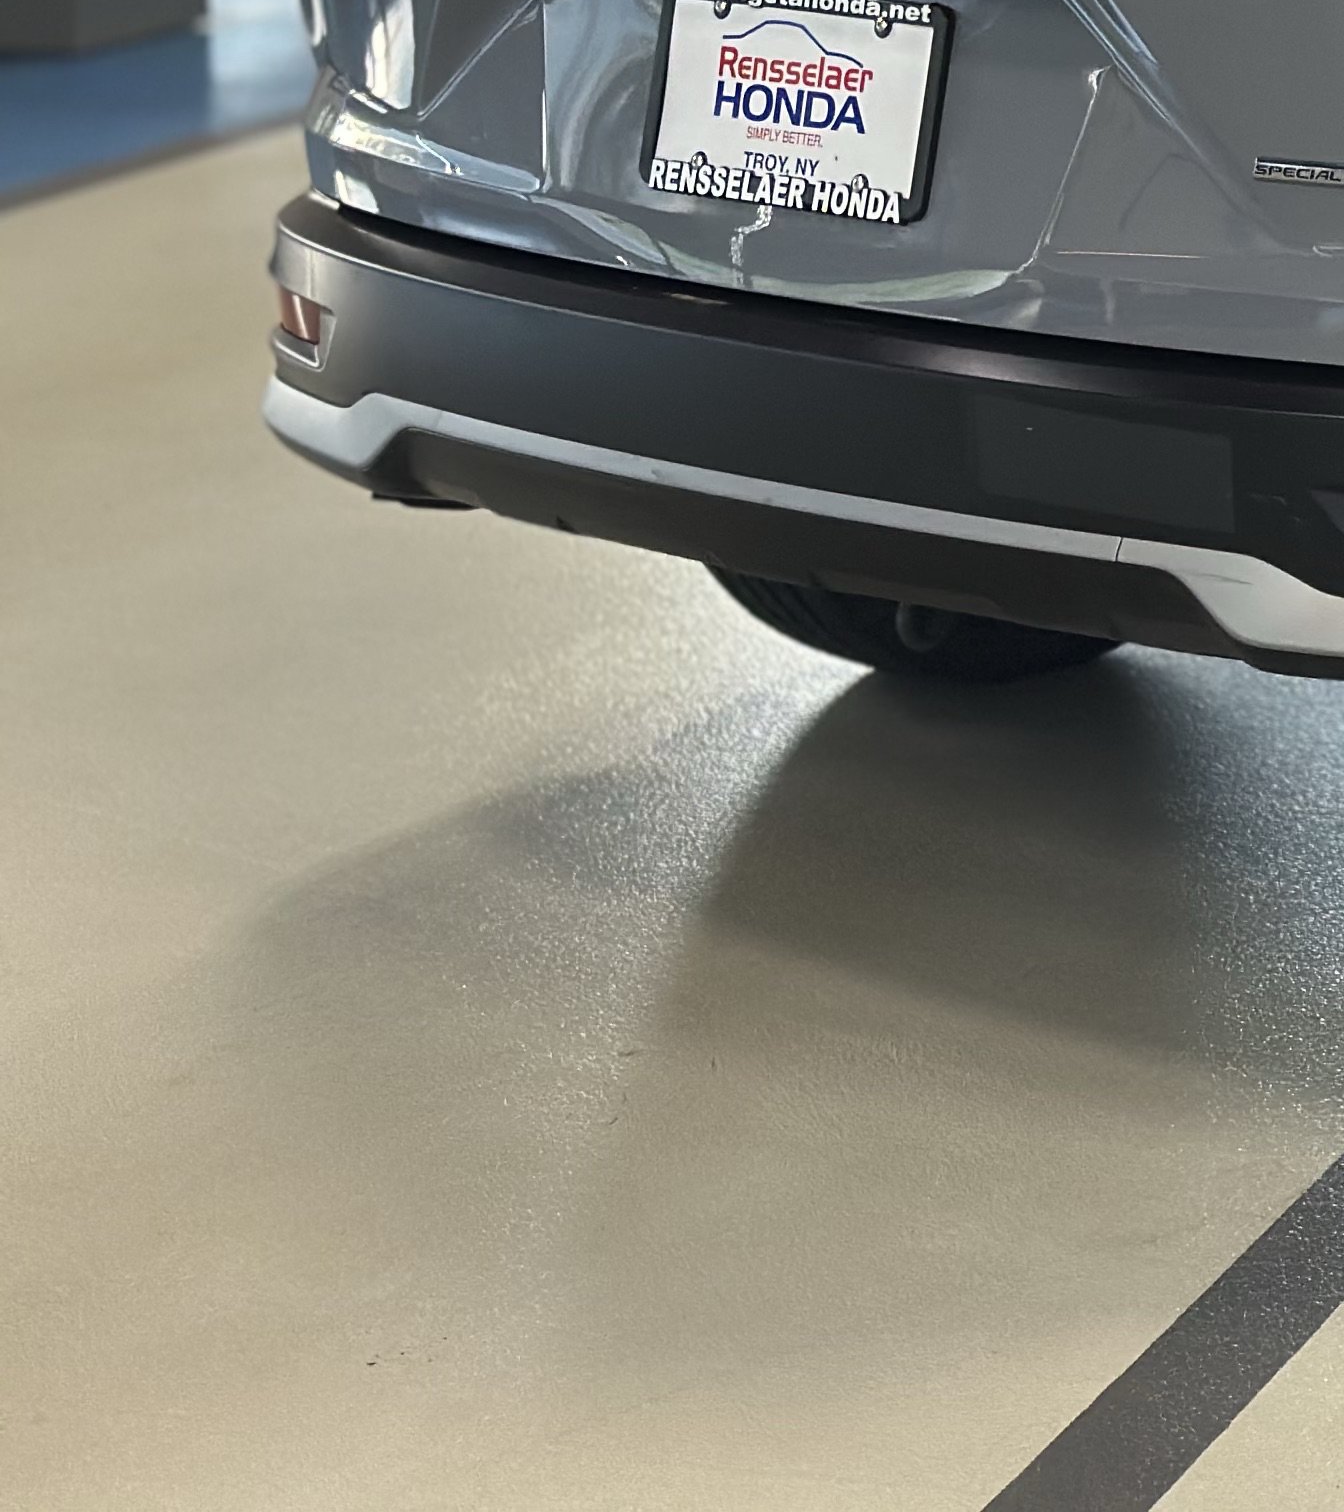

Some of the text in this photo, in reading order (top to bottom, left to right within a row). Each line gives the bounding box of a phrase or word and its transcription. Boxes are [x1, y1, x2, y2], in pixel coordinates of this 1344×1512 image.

[718, 46, 873, 93] Rensselaer
[713, 81, 865, 134] HONDA
[746, 126, 781, 142] SIMPLY
[744, 151, 819, 176] TROY, NY
[1255, 164, 1341, 182] SPECIAL
[649, 158, 900, 224] RENSSELAER HONDA
